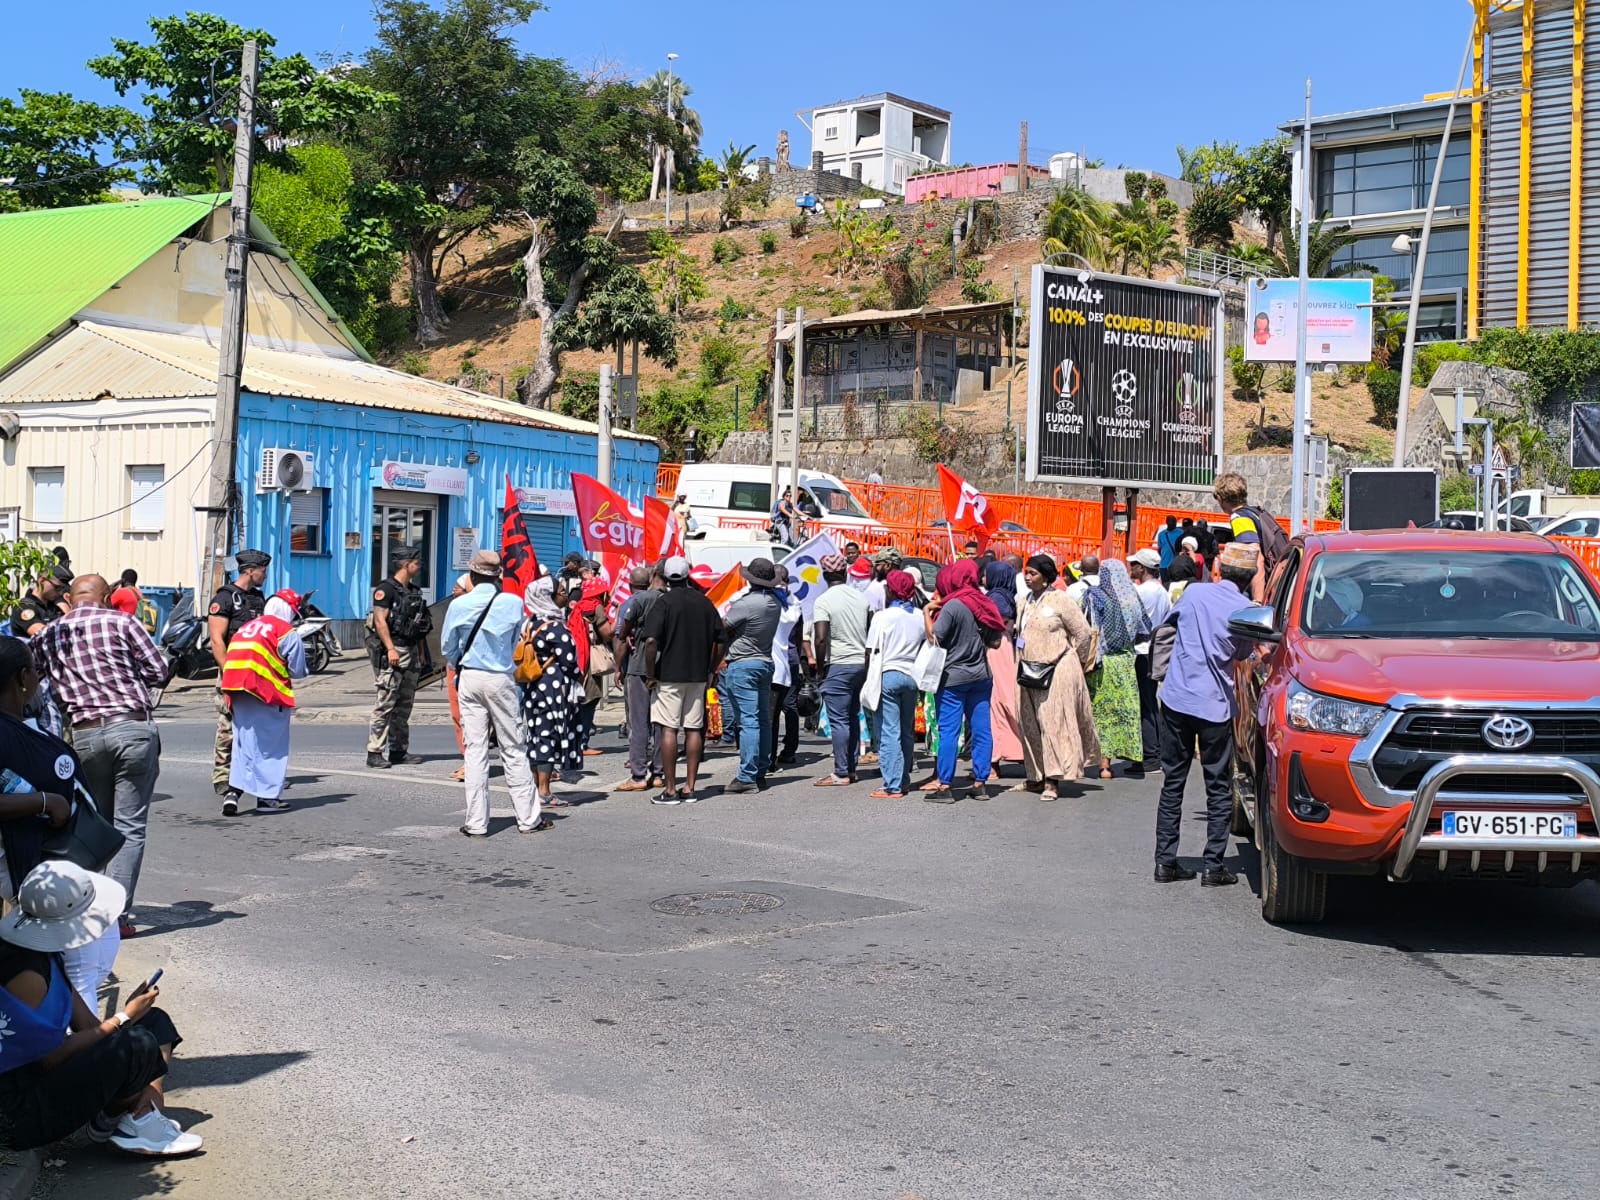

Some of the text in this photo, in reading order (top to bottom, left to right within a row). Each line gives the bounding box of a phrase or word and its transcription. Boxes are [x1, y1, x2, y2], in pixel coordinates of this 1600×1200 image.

[1047, 283, 1104, 304] CANAL+
[1293, 301, 1337, 310] DOUVREZ
[1049, 307, 1211, 340] 100% DES COUPES D'EUROPE
[1104, 331, 1120, 345] EN
[1046, 412, 1084, 425] EUROPA
[1097, 416, 1151, 429] CHAMPIONS
[1048, 424, 1081, 434] LEAGUE
[1106, 428, 1142, 438] LEAGUE
[1173, 434, 1202, 444] LEAGUE
